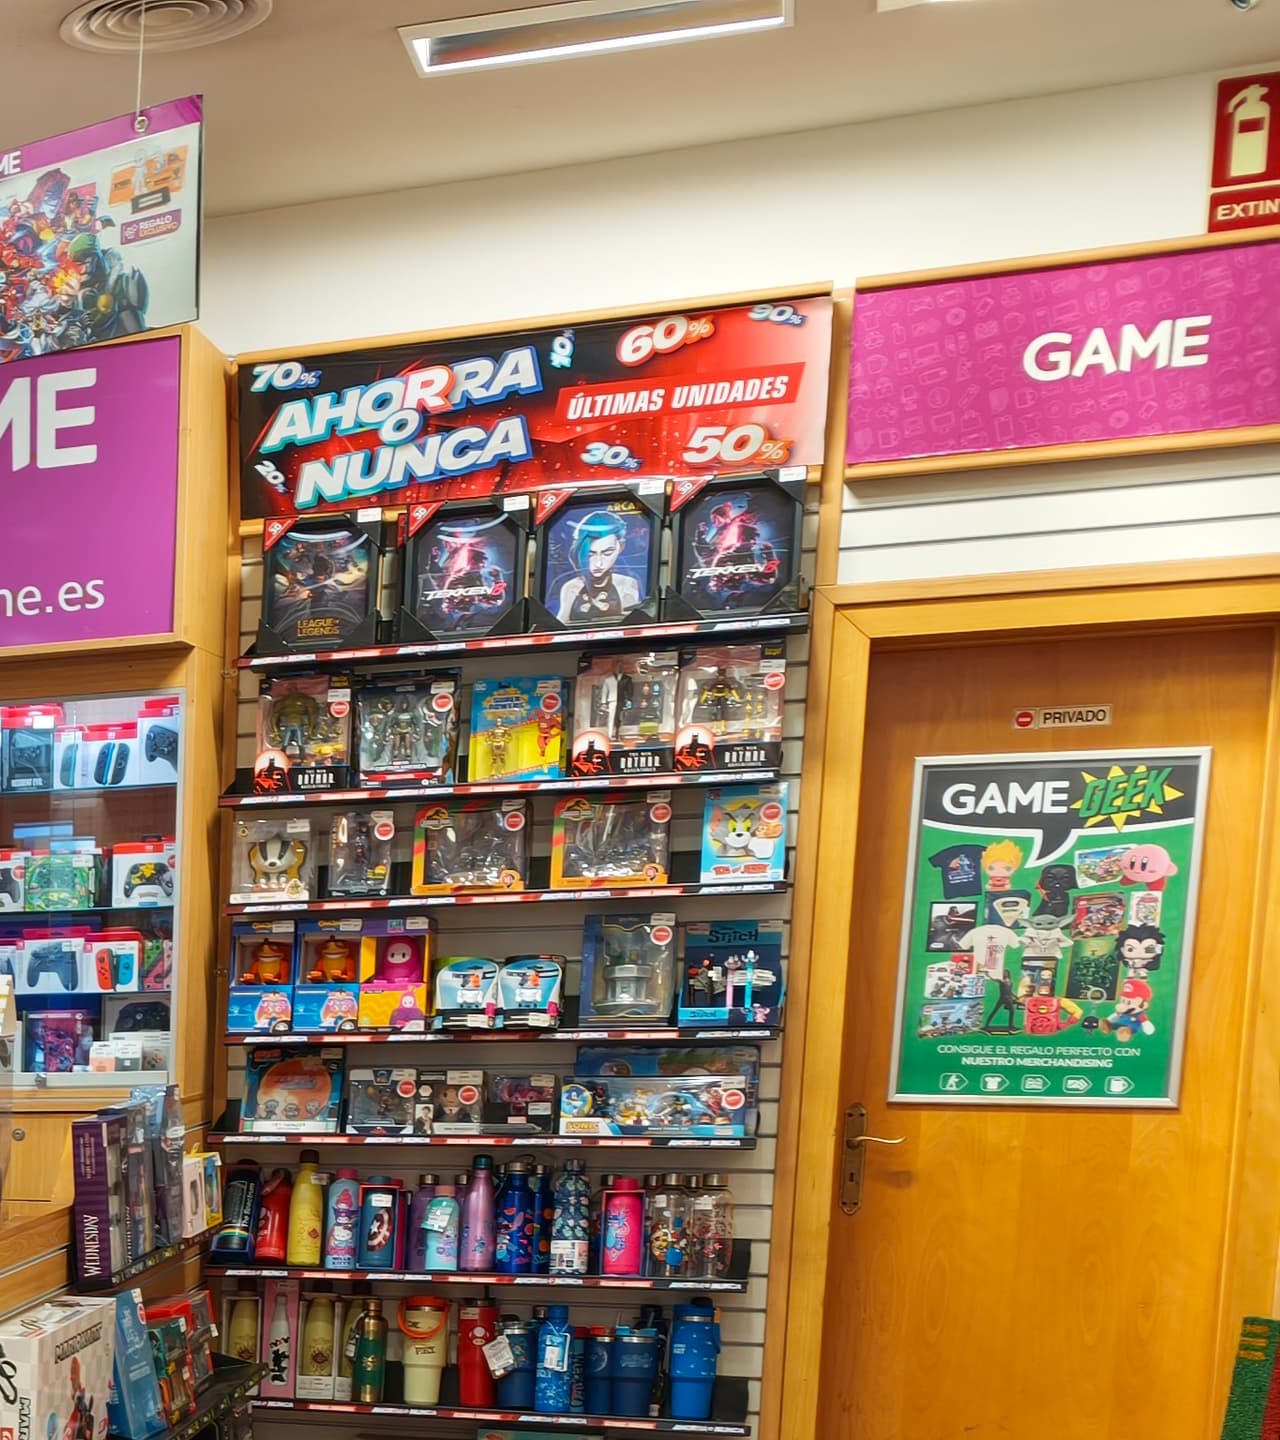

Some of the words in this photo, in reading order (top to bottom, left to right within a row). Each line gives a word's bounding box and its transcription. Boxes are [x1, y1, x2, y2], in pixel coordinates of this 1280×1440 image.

[1216, 198, 1280, 221] EXTIN
[748, 302, 806, 326] 90%
[616, 315, 715, 367] 60%
[1023, 315, 1213, 382] GAME
[250, 361, 321, 392] 70%
[259, 346, 544, 454] AHORRA
[567, 386, 665, 419] ÚLTIMAS
[672, 375, 789, 409] UNIDADES
[380, 408, 421, 446] O
[581, 442, 643, 469] 30%
[681, 423, 791, 466] 50%
[294, 415, 534, 508] NUNCA
[690, 564, 763, 578] TEKKEN
[423, 588, 492, 600] TEKKEN
[297, 618, 334, 628] LEAGUE
[297, 626, 339, 636] LEGENDS
[1043, 709, 1107, 725] PRIVADO
[942, 780, 1070, 815] GAME
[1078, 767, 1173, 818] GEEK
[937, 1044, 993, 1055] CONSIGUE
[996, 1045, 1008, 1055] EL
[1010, 1045, 1054, 1055] REGALO
[1055, 1046, 1113, 1056] PERFECTO
[1114, 1047, 1141, 1057] CON
[961, 1057, 1014, 1067] NUESTRO
[1016, 1057, 1113, 1068] MERCHANDISING
[83, 1213, 99, 1278] WEDNESDAY
